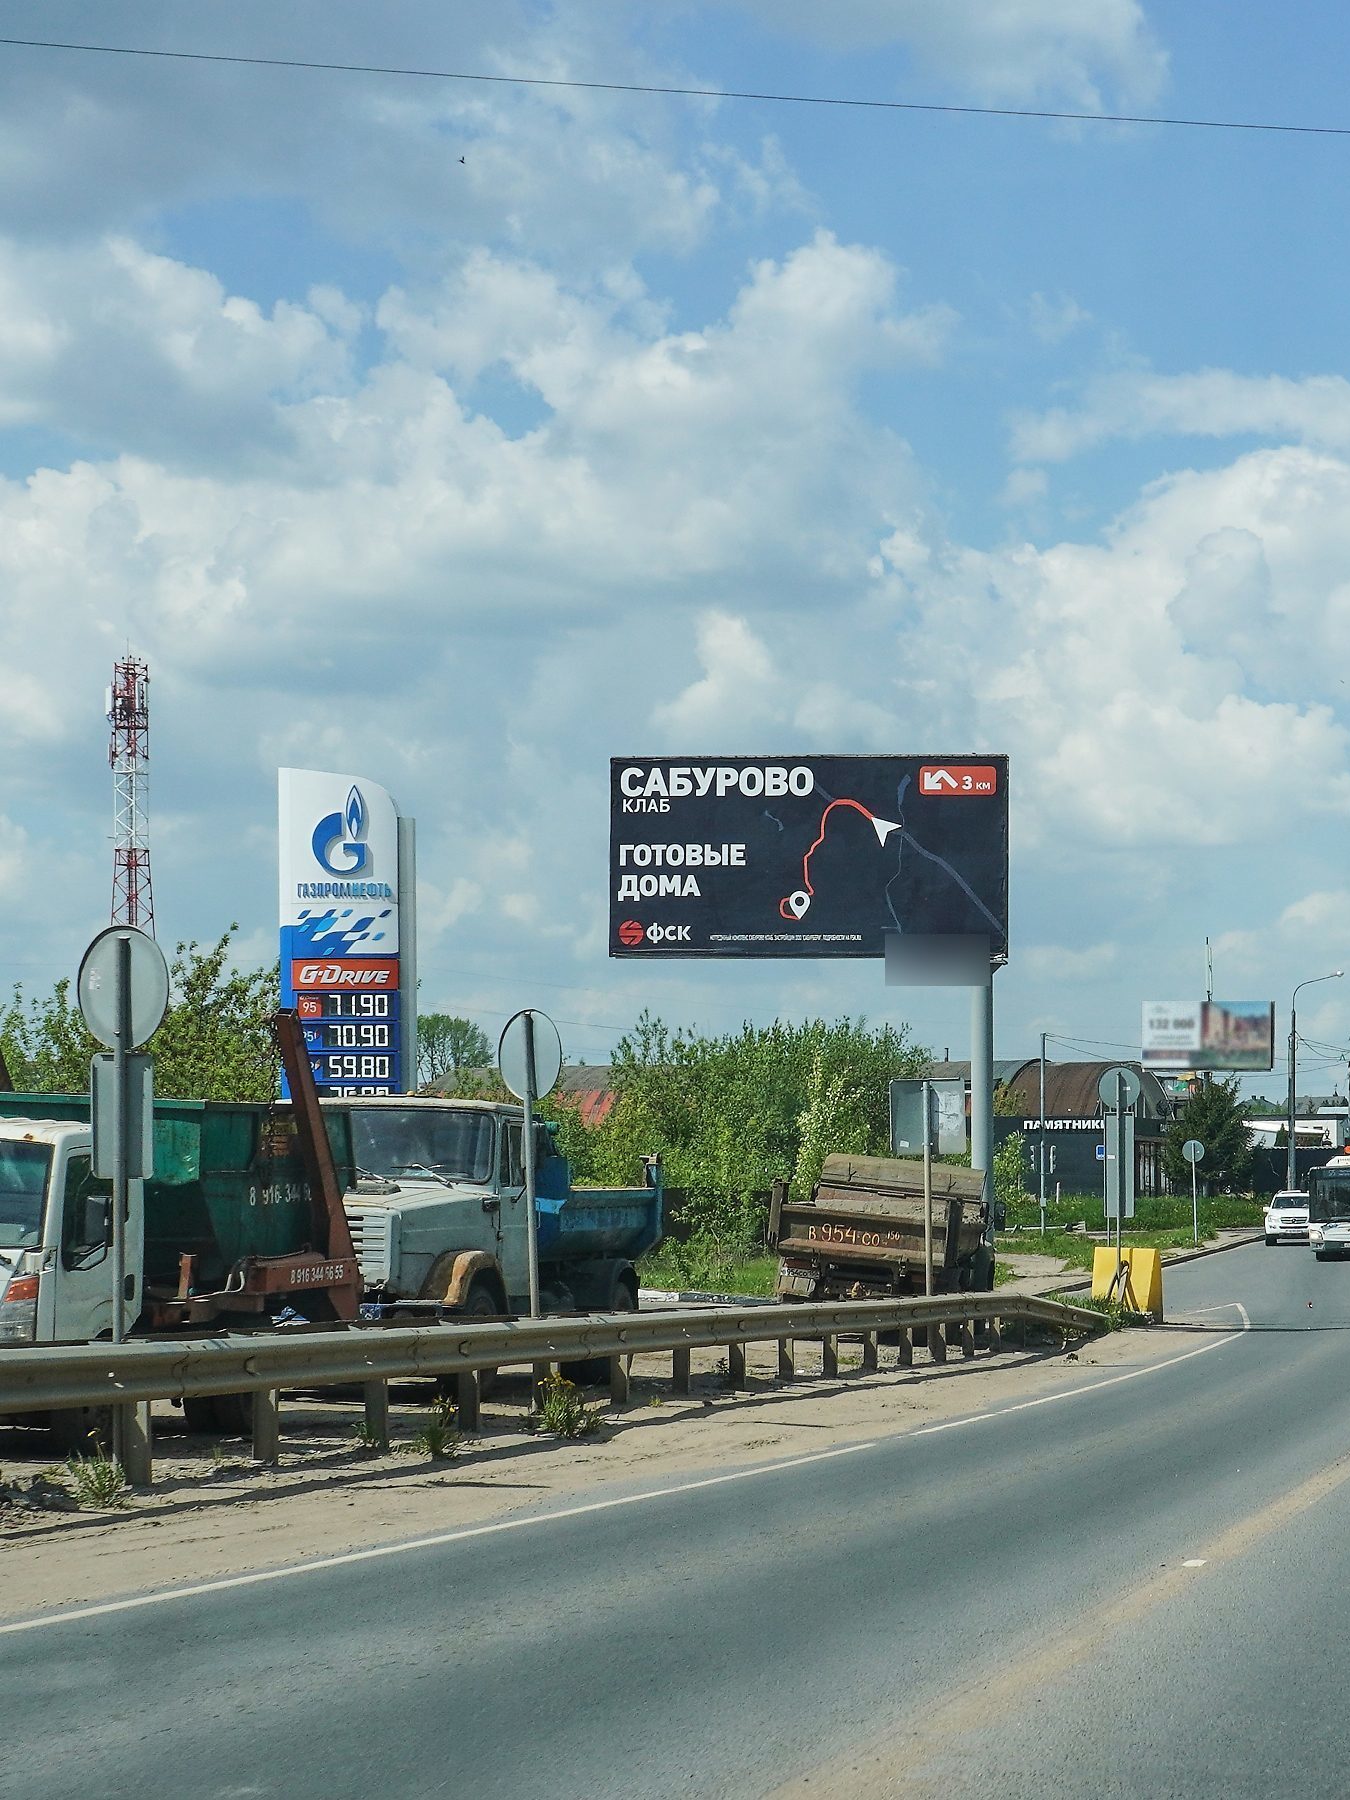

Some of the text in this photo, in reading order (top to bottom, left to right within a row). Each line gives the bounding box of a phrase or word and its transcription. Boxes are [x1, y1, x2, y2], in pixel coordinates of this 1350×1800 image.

[620, 766, 814, 797] САБУРОВО
[962, 775, 973, 790] 3
[622, 799, 671, 813] КЛАБ
[619, 844, 746, 866] ГОТОВЫЕ
[297, 882, 392, 899] ГАЗПРОМНЕФТЬ
[617, 874, 701, 902] ДОМА
[302, 994, 389, 1017] 95 71.90
[328, 1025, 389, 1047] 70.90
[328, 1056, 389, 1078] 59.80
[249, 1186, 256, 1206] 8
[887, 1230, 900, 1241] 150
[290, 1269, 296, 1285] 8
[296, 1267, 310, 1284] 916
